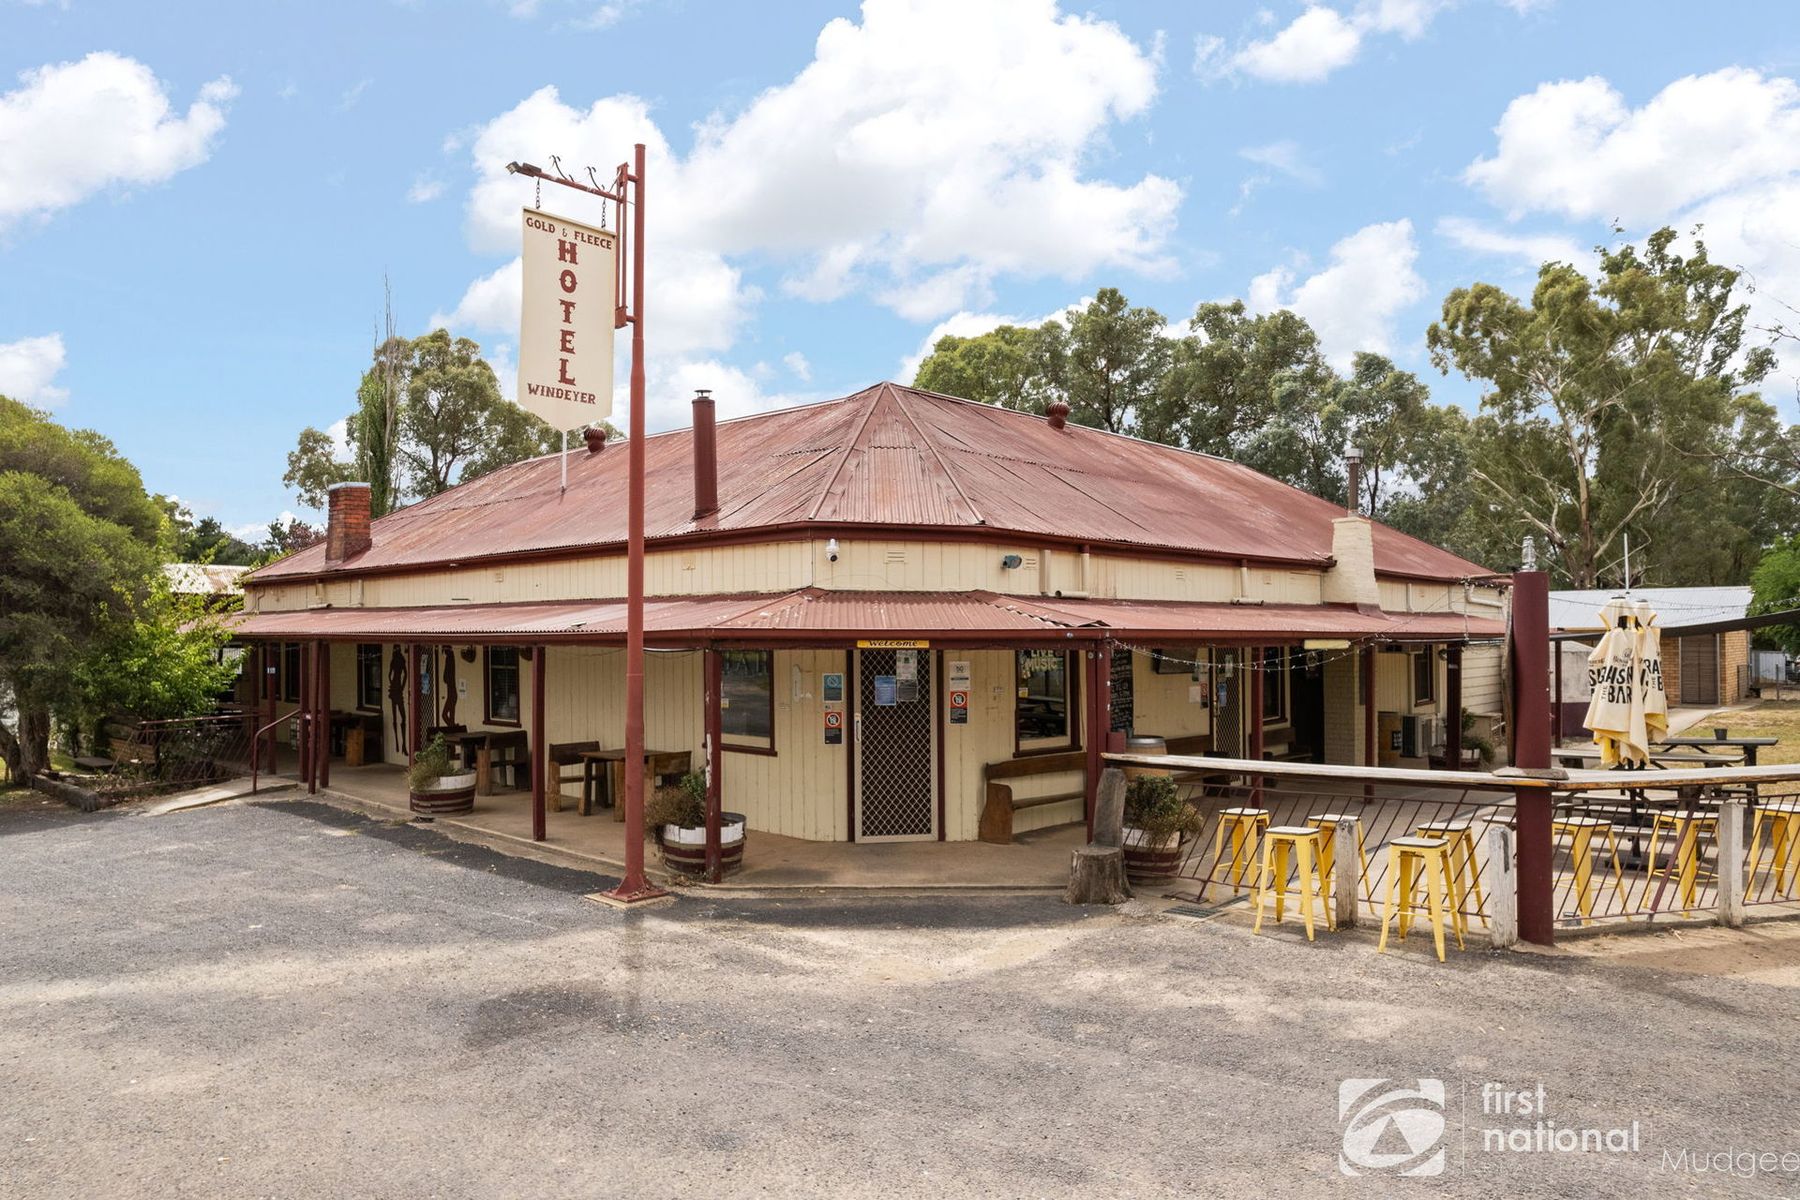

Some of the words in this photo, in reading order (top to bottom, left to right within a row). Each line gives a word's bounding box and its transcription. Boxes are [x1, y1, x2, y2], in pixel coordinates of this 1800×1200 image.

[526, 216, 556, 234] GOLD
[574, 230, 612, 250] FLEECE
[557, 238, 579, 387] HOTEL
[527, 382, 597, 405] WINDEYER
[1027, 657, 1058, 672] MUSIC
